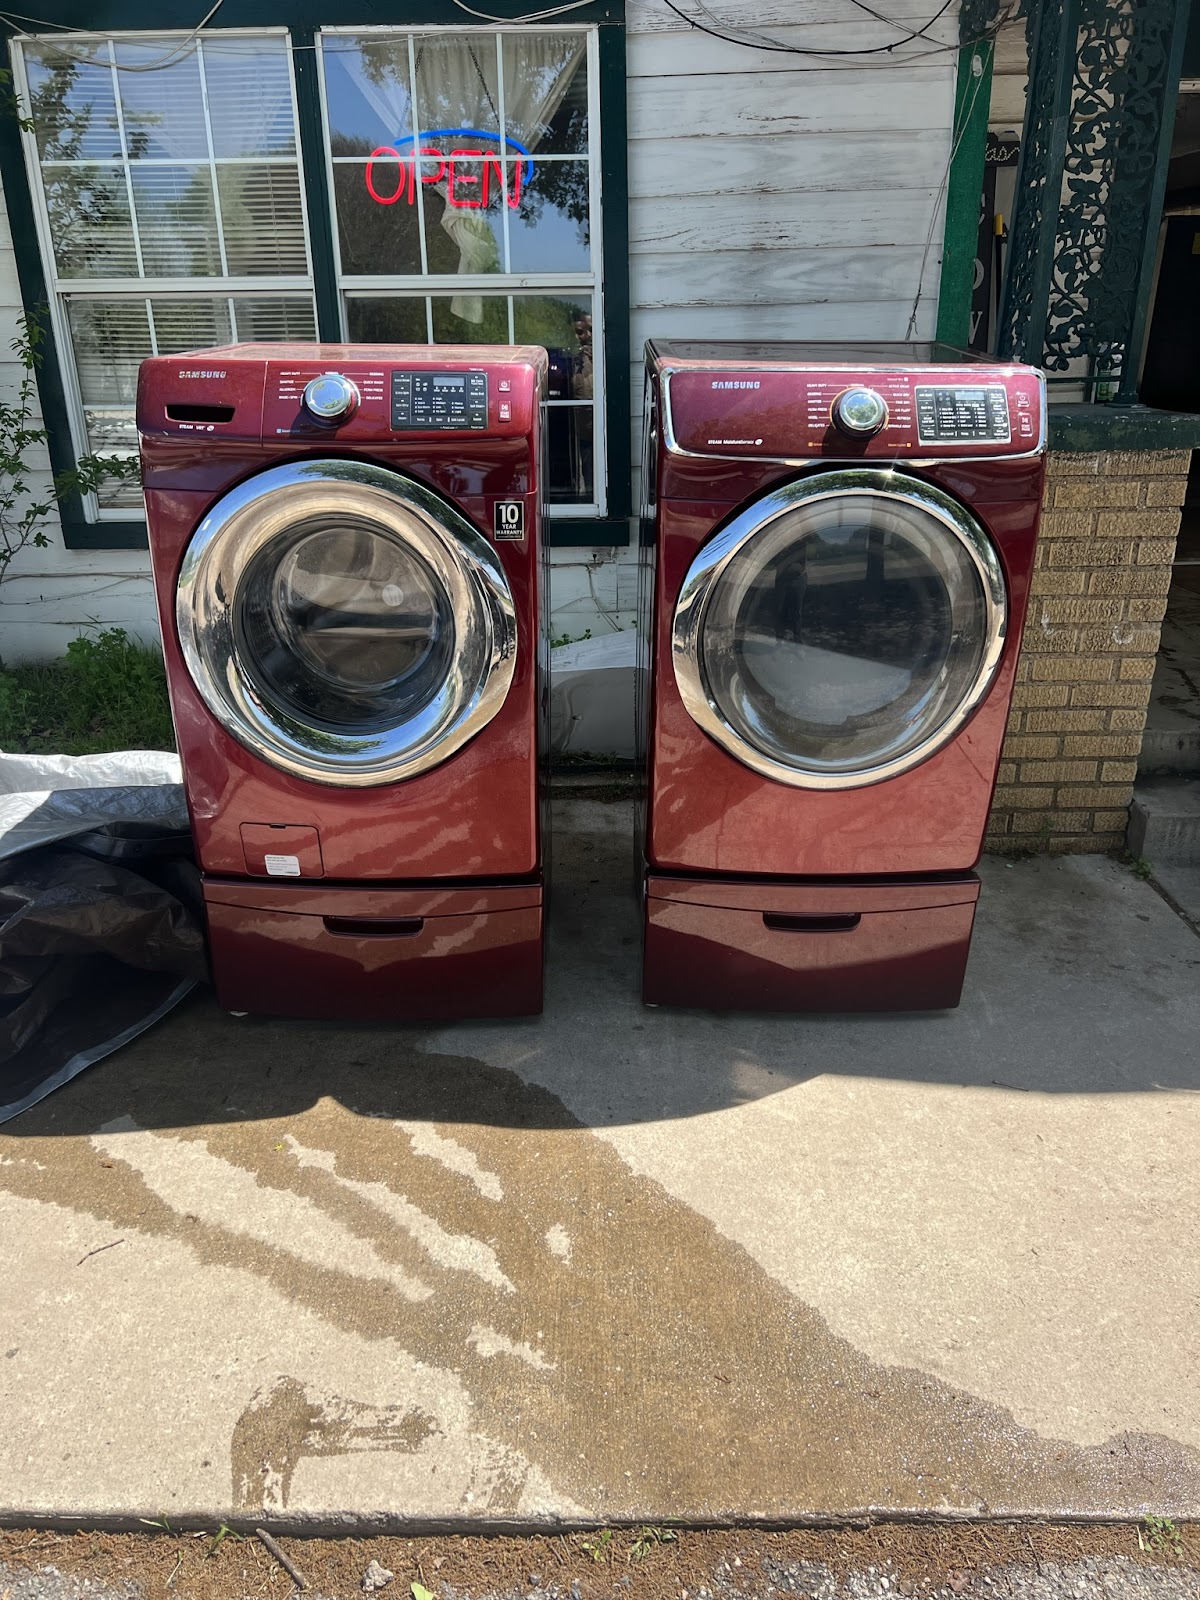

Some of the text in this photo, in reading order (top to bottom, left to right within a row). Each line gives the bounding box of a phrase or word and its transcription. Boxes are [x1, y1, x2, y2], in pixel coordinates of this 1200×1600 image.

[365, 146, 523, 209] OPEN
[179, 371, 227, 379] SAMSUNG
[711, 381, 761, 390] SAMSUNG
[499, 504, 519, 524] 10
